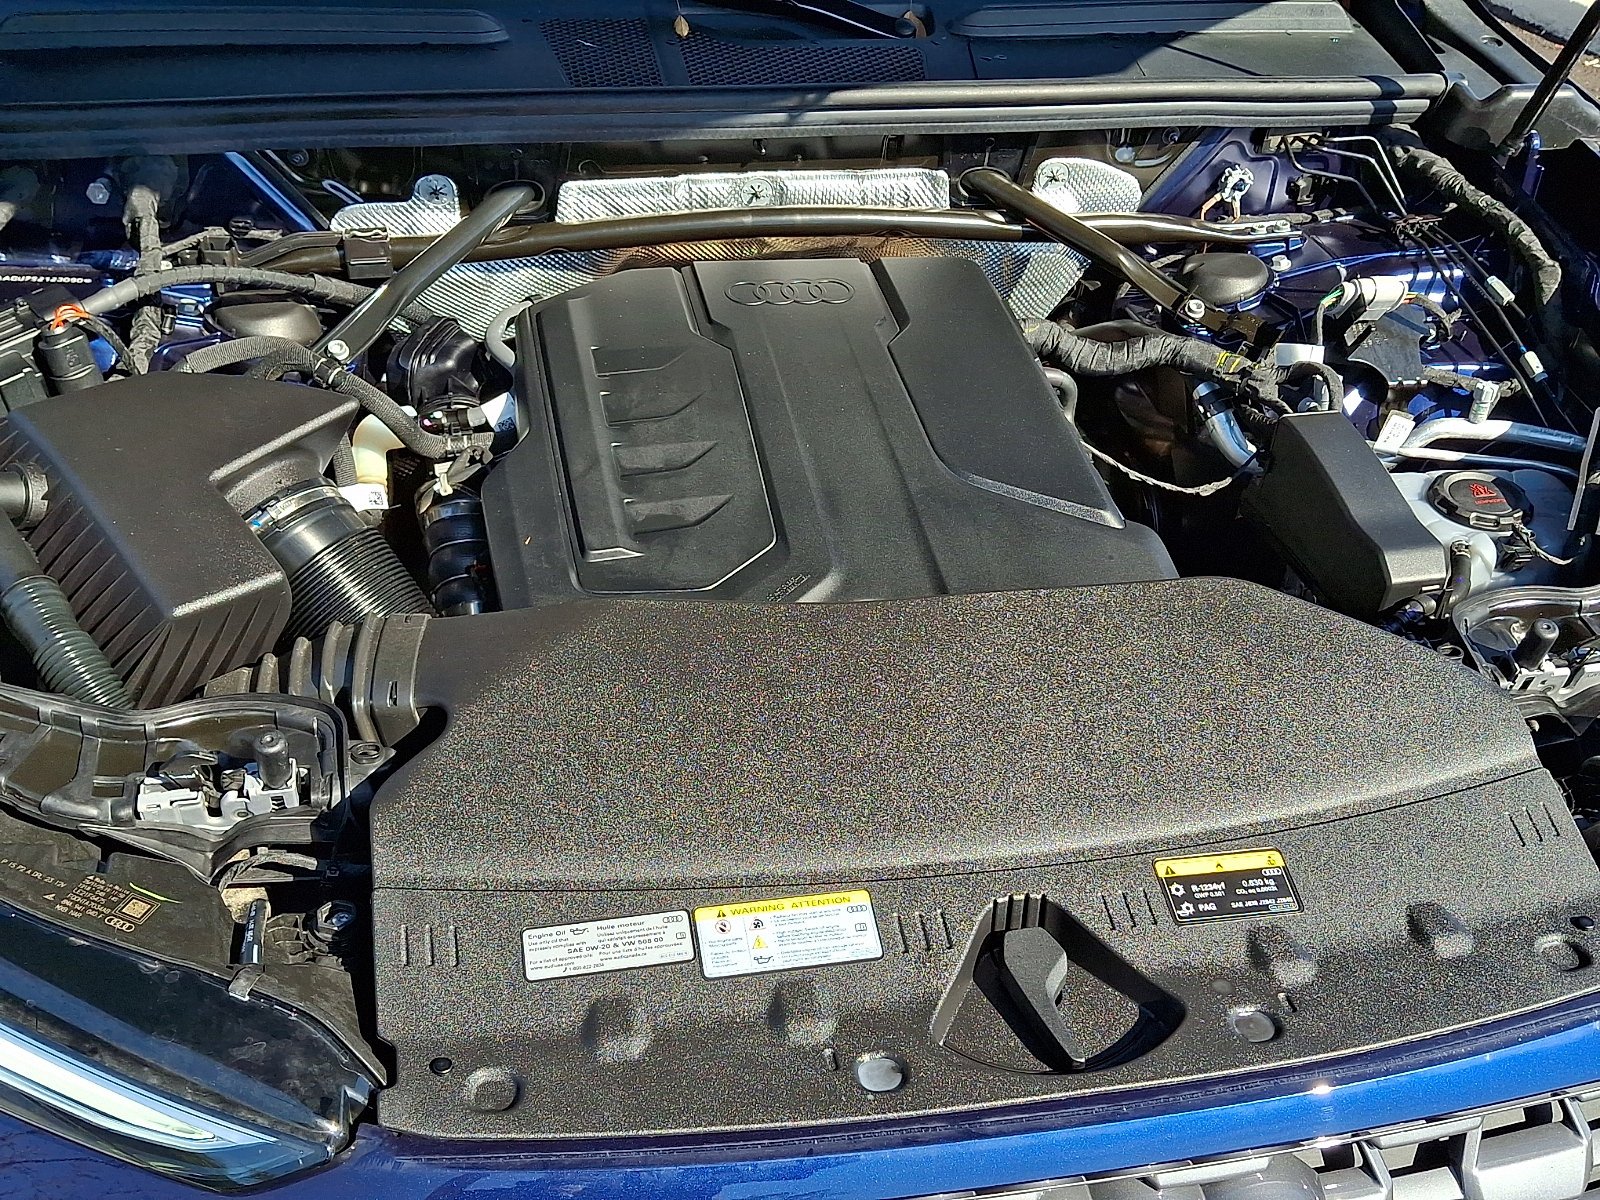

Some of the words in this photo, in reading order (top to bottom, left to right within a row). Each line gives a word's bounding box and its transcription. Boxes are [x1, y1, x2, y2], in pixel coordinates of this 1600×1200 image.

[730, 904, 785, 915] WARNING
[792, 897, 851, 908] ATTENTION
[1198, 903, 1217, 912] PAG
